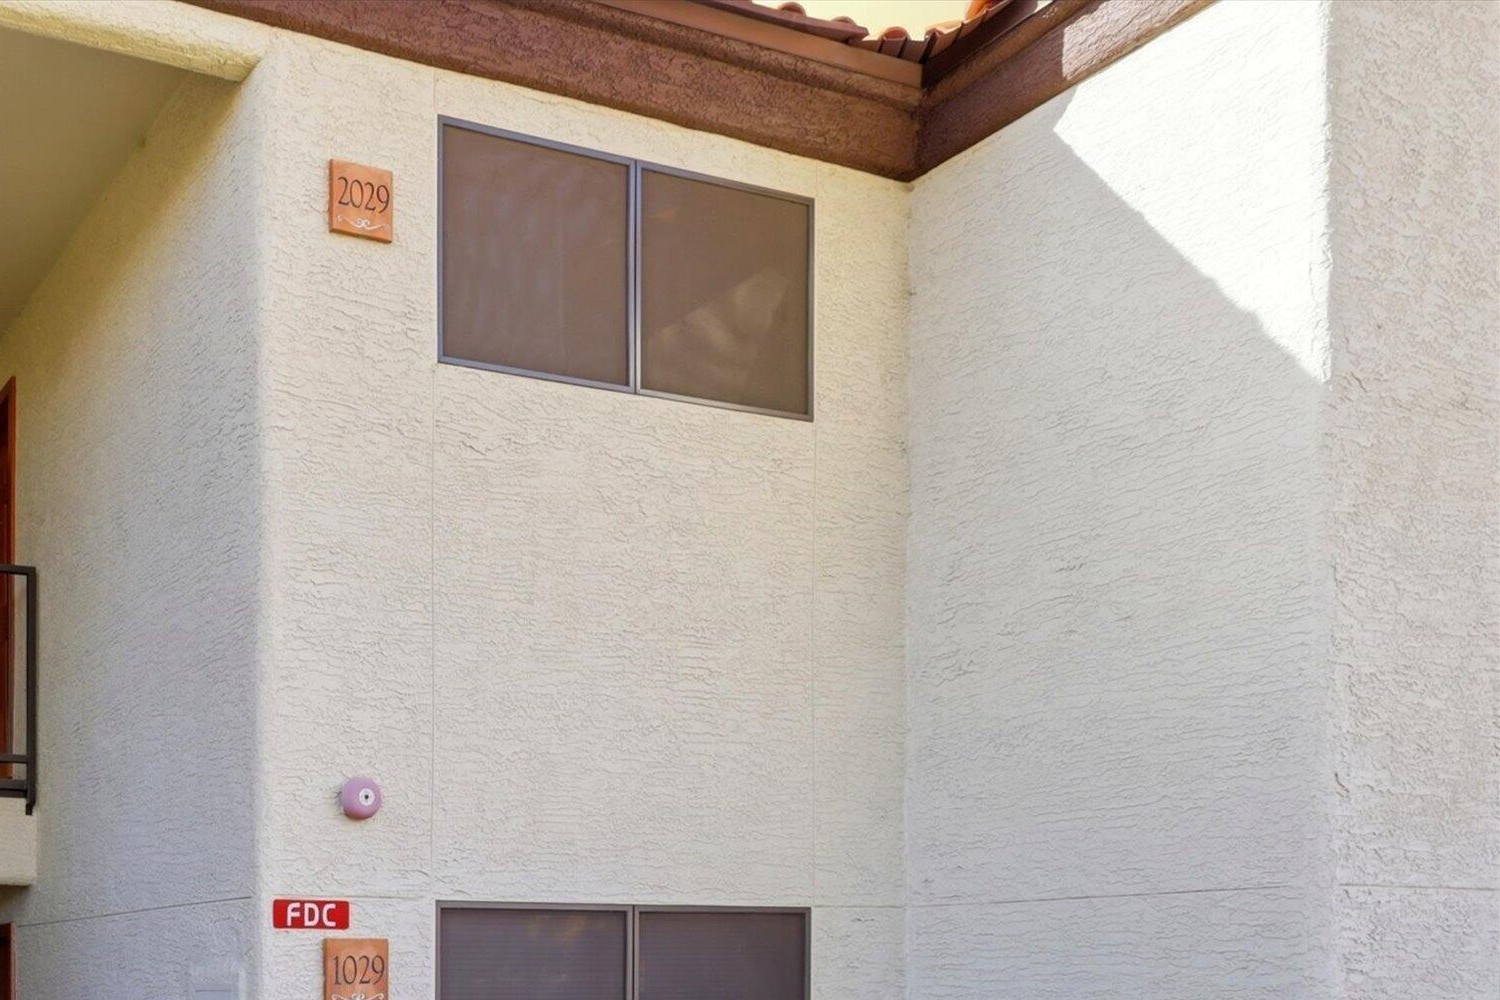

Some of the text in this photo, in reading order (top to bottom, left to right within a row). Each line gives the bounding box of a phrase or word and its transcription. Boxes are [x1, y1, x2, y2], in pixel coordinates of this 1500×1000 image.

[338, 176, 390, 213] 2029
[286, 902, 337, 927] FDC
[332, 955, 385, 985] 1029
